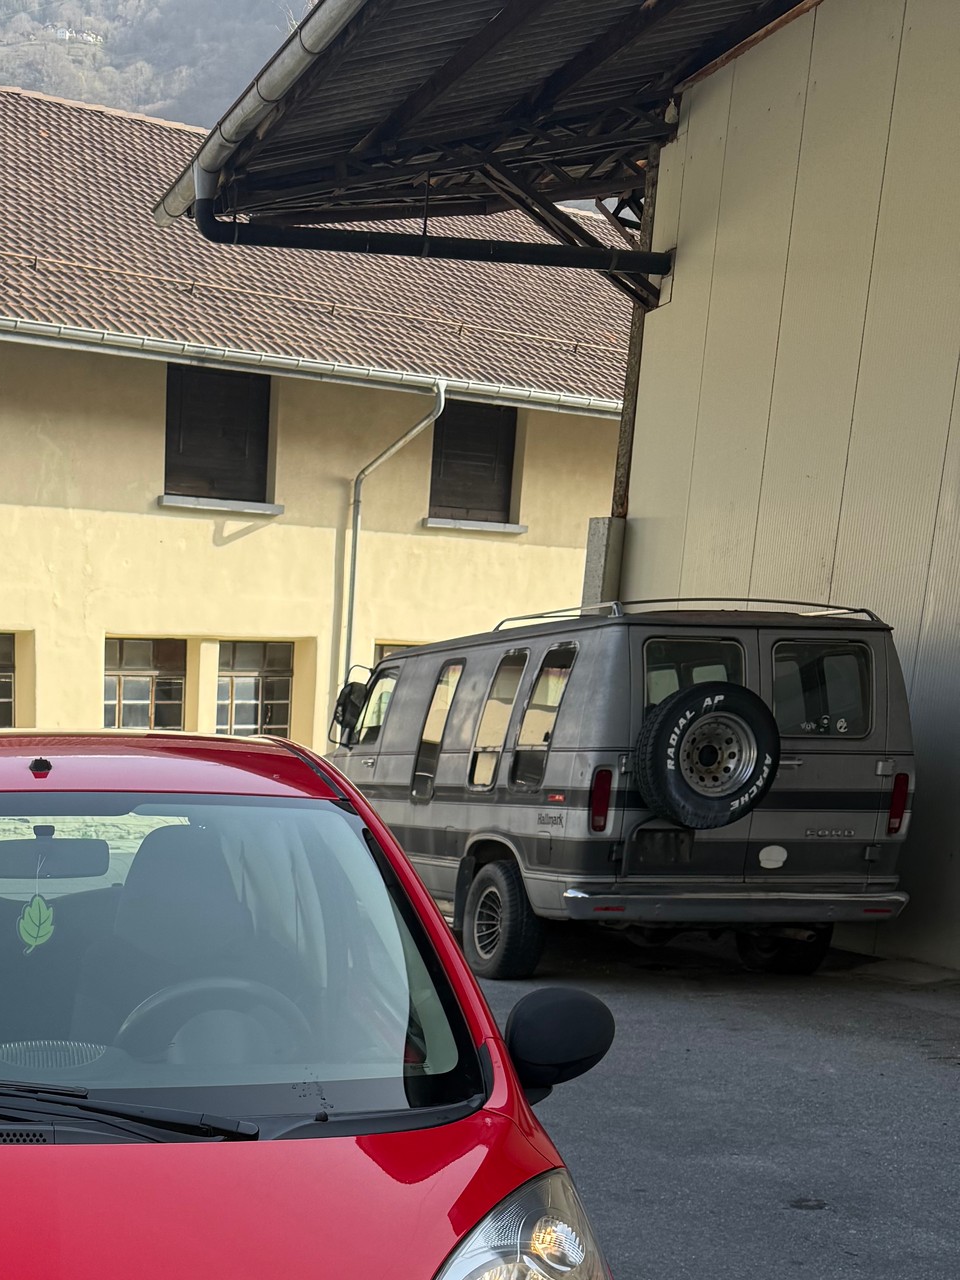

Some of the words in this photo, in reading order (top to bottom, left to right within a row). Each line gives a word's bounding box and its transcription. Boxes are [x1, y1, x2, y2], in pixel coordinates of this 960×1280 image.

[666, 709, 695, 770] RADIAL
[702, 695, 725, 708] AP
[730, 753, 772, 811] APACHE
[537, 813, 564, 828] Hallmark
[805, 828, 856, 838] FORD
